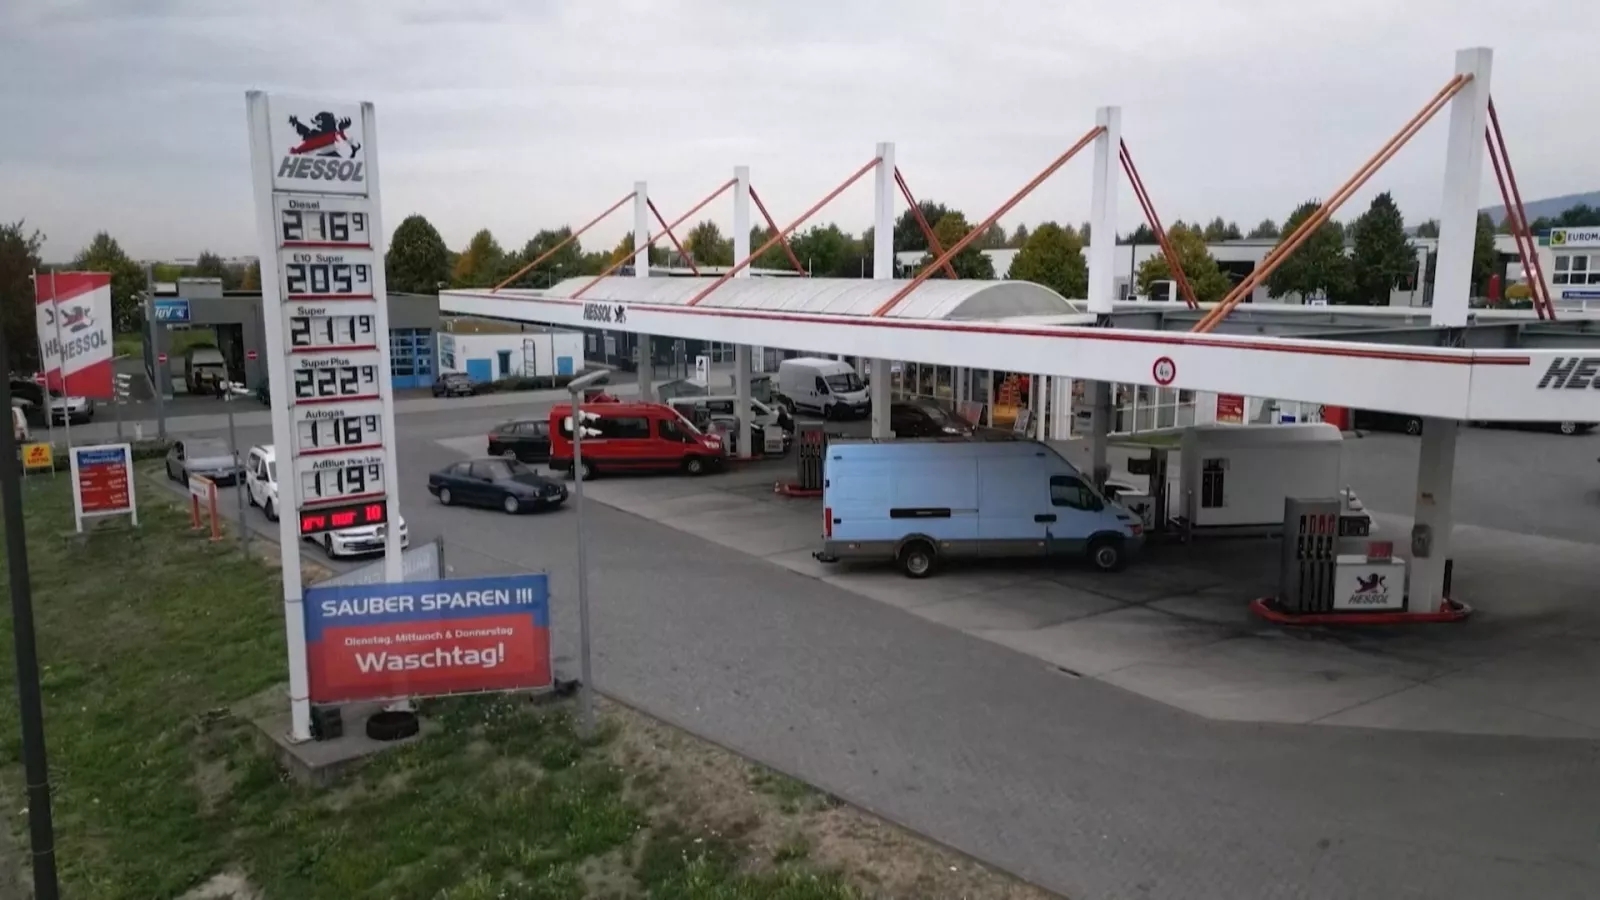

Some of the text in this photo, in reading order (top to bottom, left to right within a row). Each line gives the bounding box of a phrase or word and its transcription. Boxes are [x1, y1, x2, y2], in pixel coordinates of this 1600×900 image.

[277, 157, 364, 181] HESSOL
[289, 201, 320, 209] Diesel
[294, 254, 344, 264] E10 Super
[287, 264, 367, 293] 2059
[298, 306, 326, 316] Super
[583, 303, 612, 322] HESSOL
[60, 330, 108, 362] HESSOL
[295, 366, 373, 399] 2229
[305, 410, 344, 420] Autogas
[313, 459, 345, 469] AdBlue
[365, 505, 382, 521] 10
[321, 589, 532, 617] SAUBER SPAREN !!!
[344, 626, 514, 647] Dienstag, Mittwoch & Donnerstag
[355, 642, 505, 674] Waschtag!
